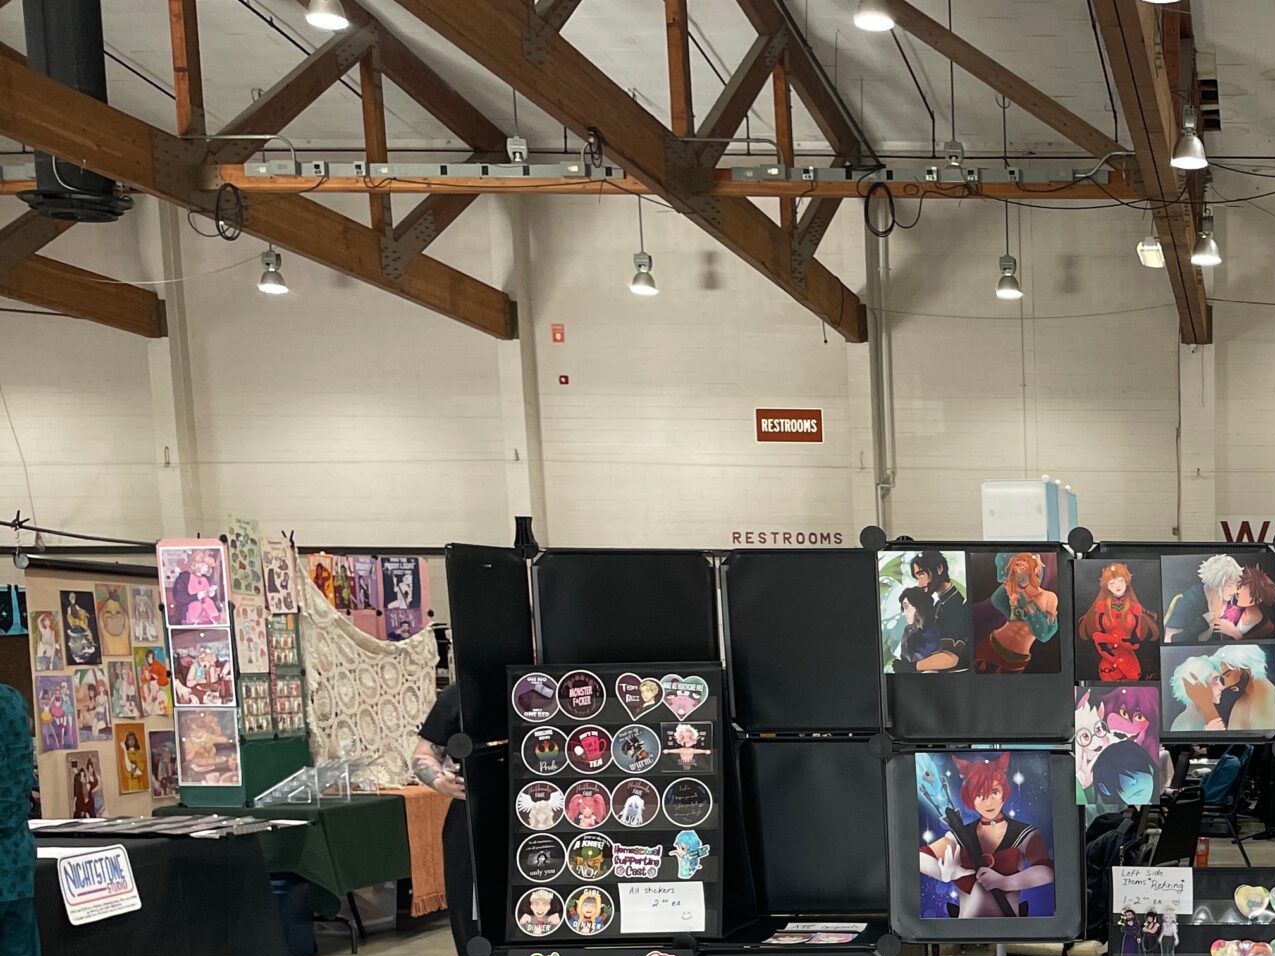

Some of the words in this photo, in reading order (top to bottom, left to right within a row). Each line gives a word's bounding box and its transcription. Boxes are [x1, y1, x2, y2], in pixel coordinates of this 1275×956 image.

[761, 419, 817, 433] RESTROOMS
[732, 532, 843, 545] RESTROOMS
[569, 686, 593, 698] MONSTER
[614, 855, 660, 868] Supporting
[63, 854, 126, 898] NIGHTSTONE
[626, 866, 647, 876] Cast
[1122, 869, 1140, 877] Left
[106, 879, 128, 894] STUDIO
